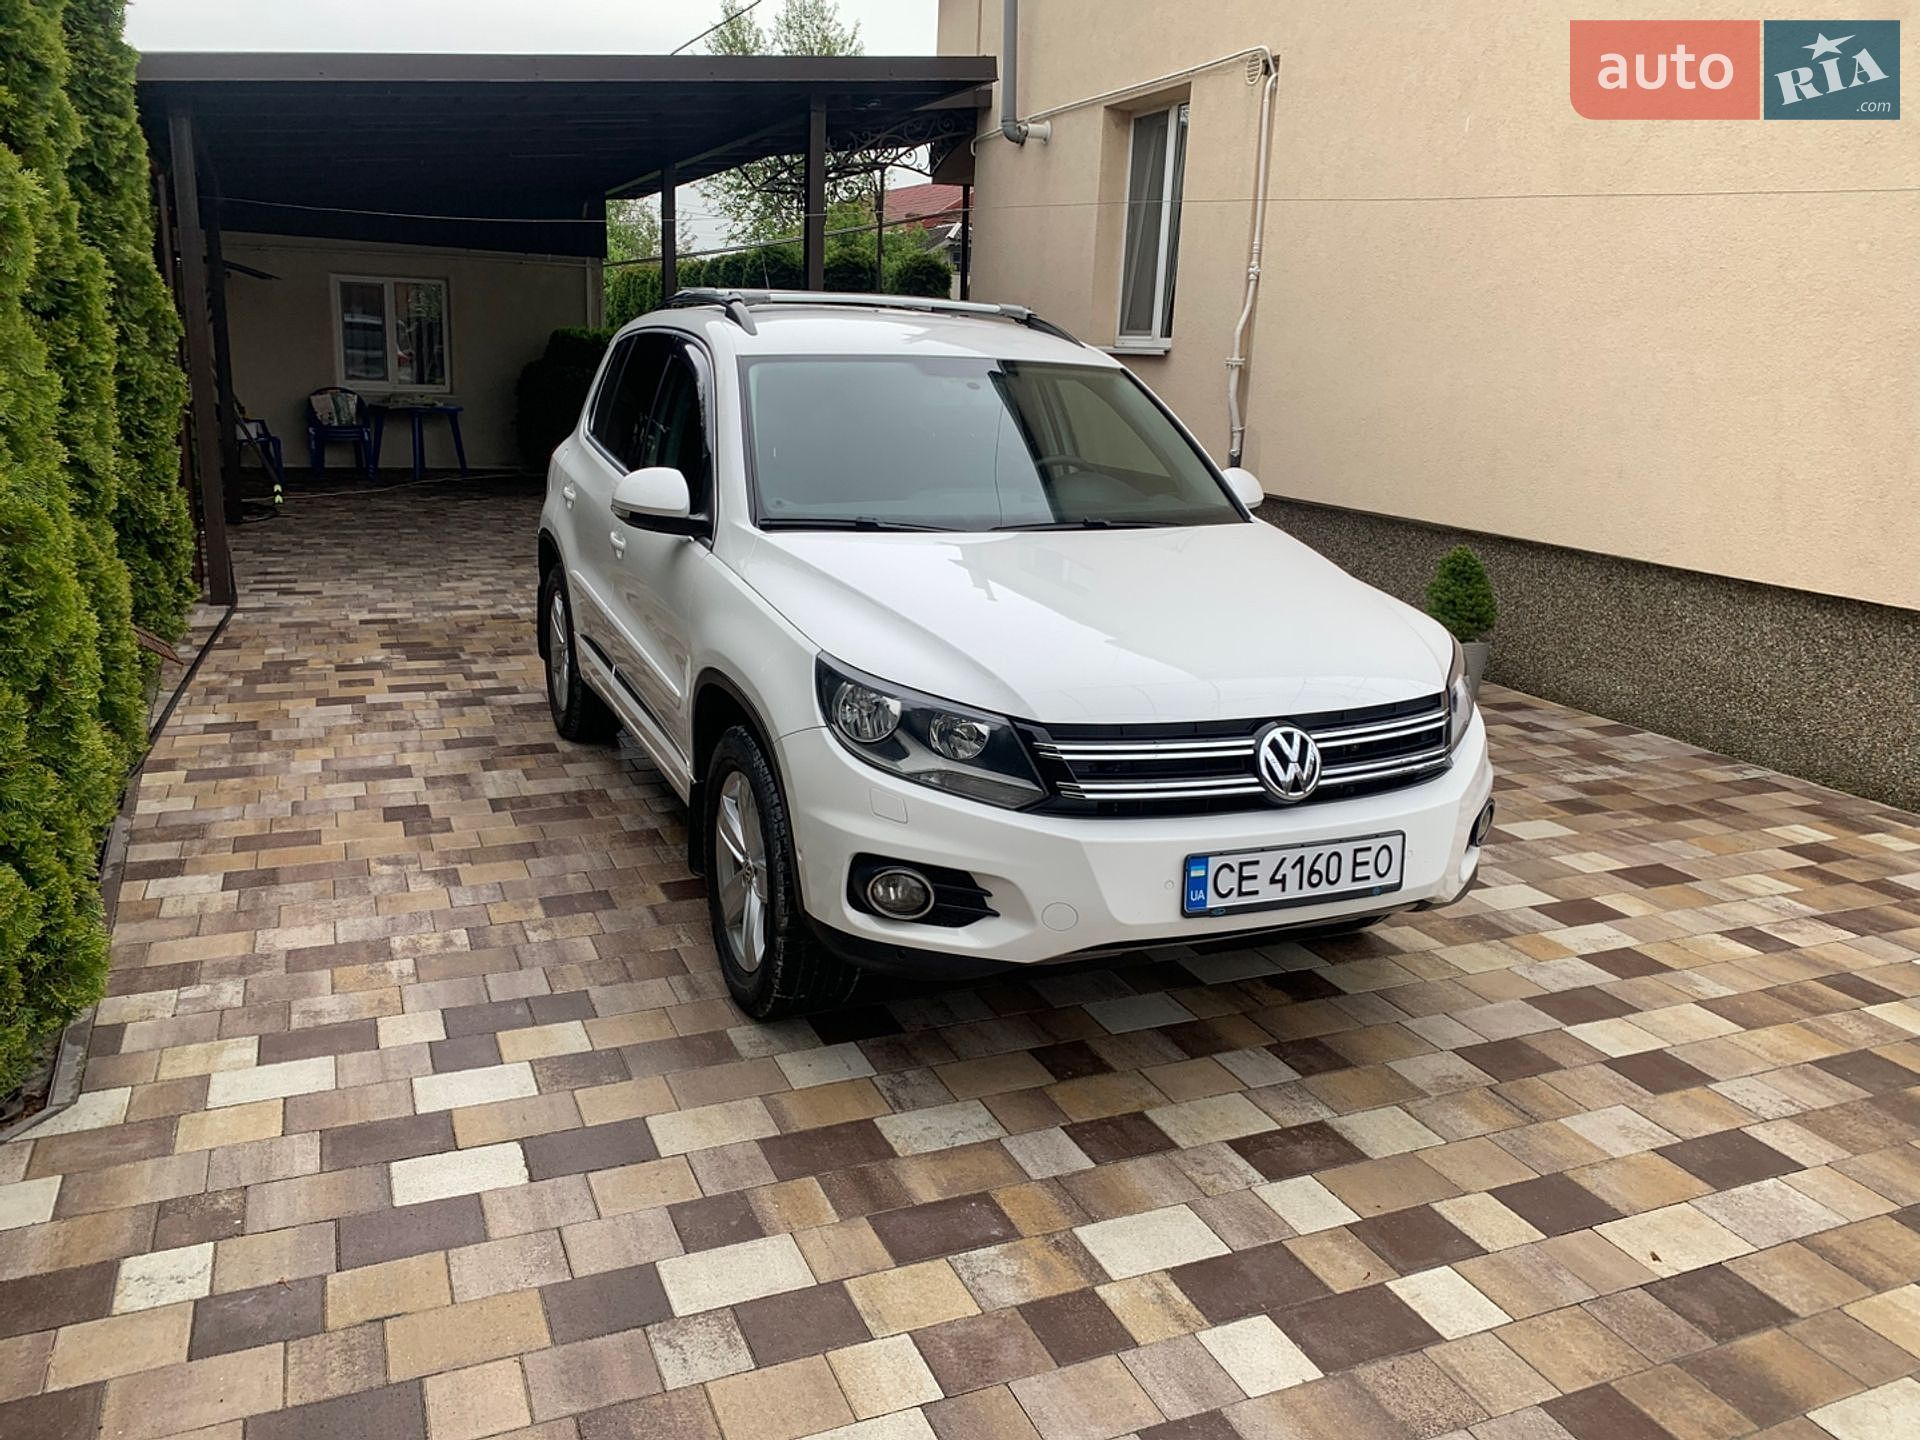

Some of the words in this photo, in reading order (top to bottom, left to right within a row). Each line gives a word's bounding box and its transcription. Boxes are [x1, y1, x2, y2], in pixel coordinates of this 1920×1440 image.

[1213, 860, 1260, 898] CE
[1269, 851, 1342, 892] 4160
[1351, 844, 1393, 882] EO
[1190, 890, 1206, 901] UA
